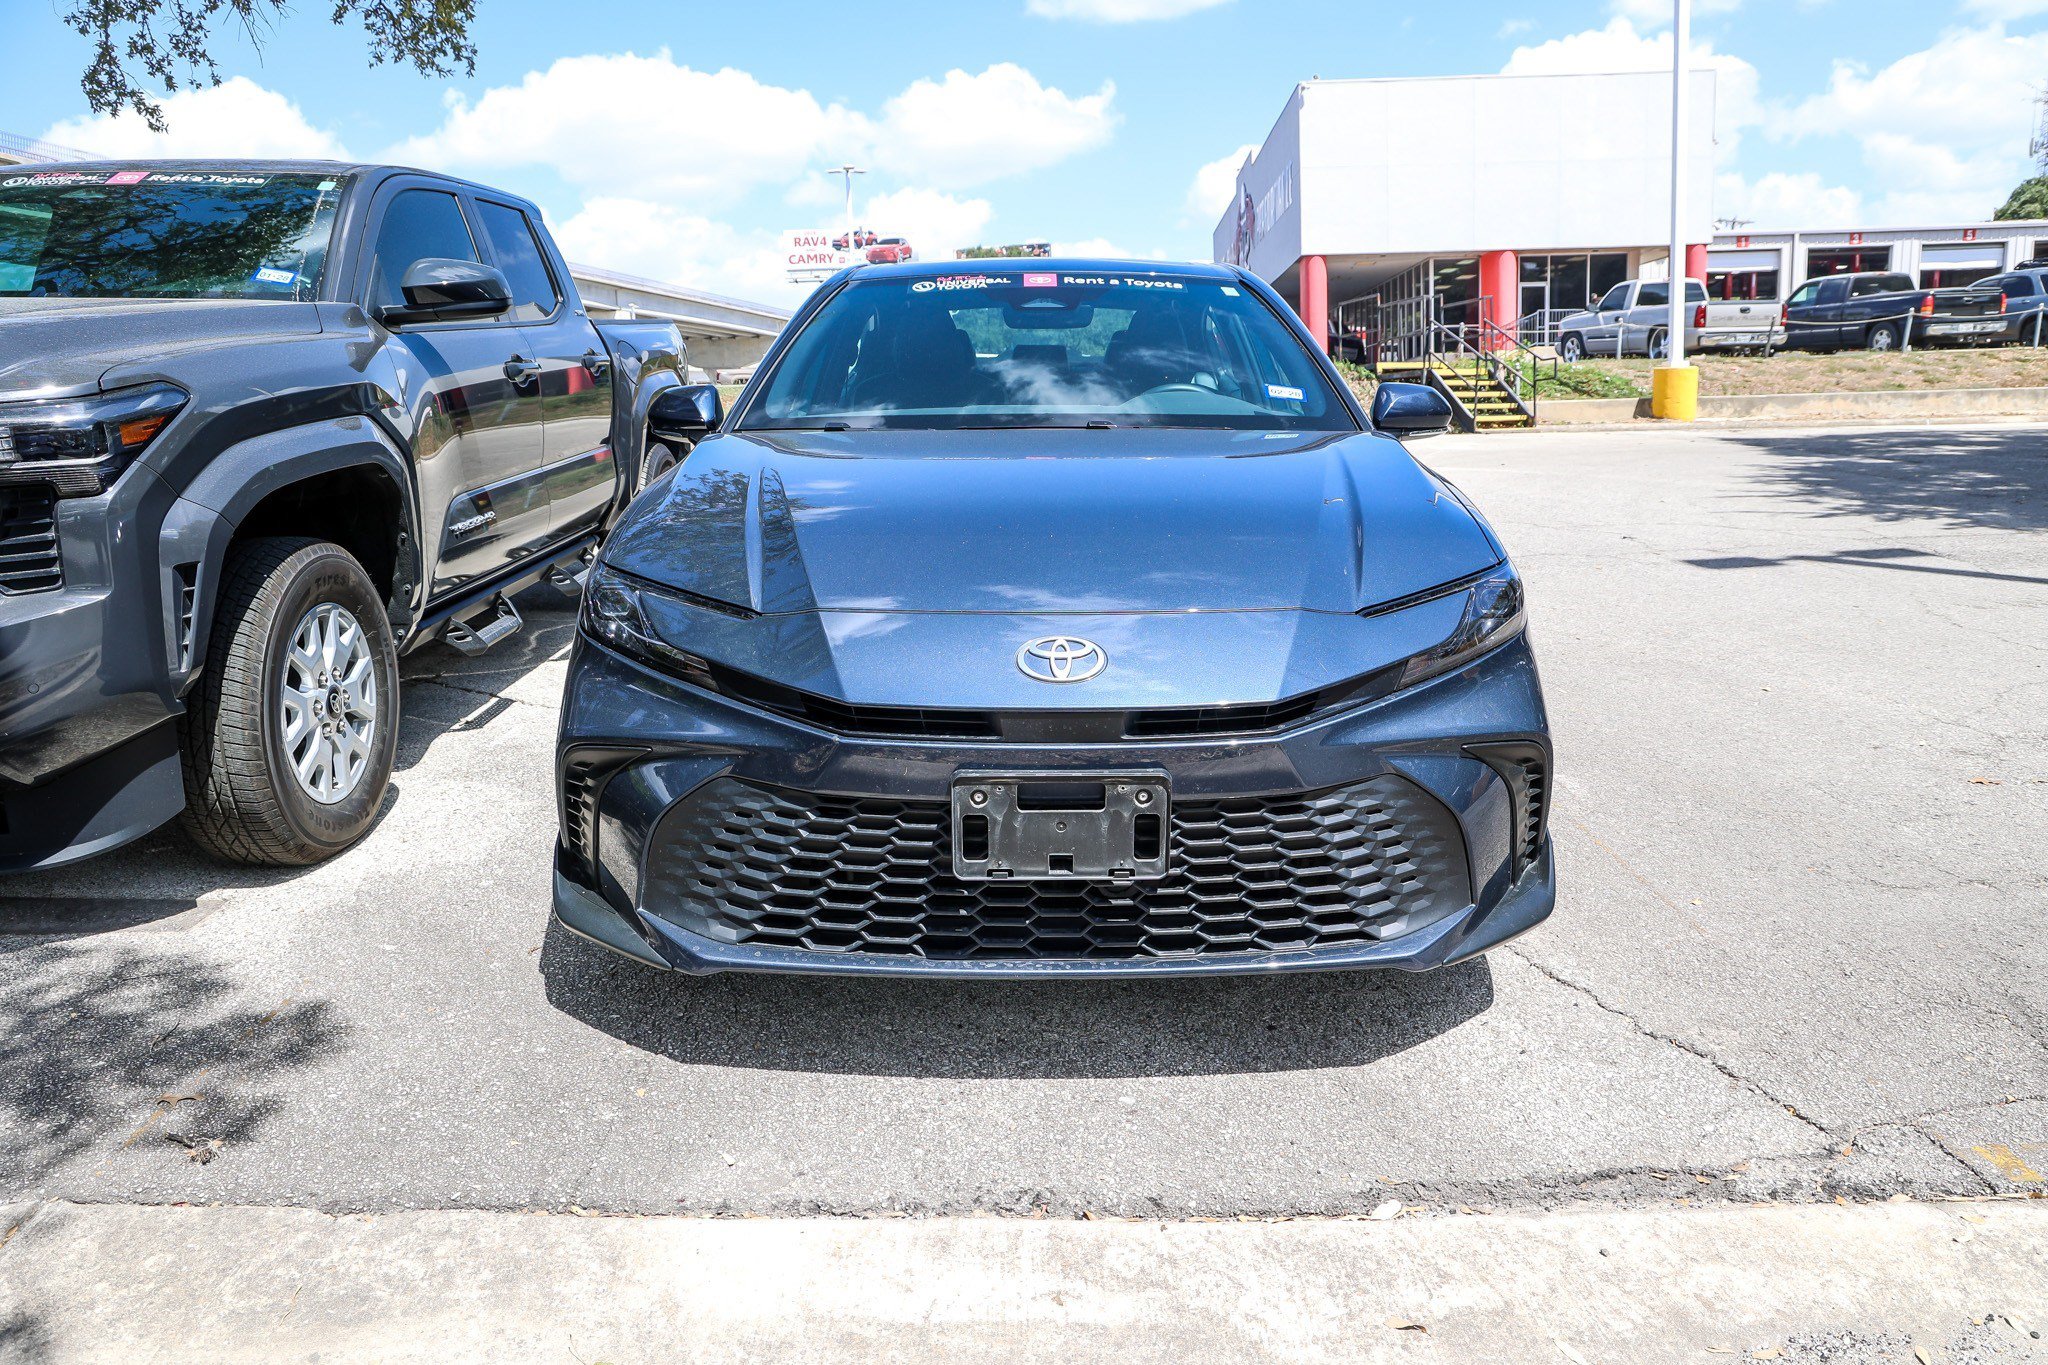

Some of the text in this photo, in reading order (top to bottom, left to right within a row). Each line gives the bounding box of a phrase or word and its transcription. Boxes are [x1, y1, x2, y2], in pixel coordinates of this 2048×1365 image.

[146, 174, 265, 184] Rent a Toyota
[1966, 229, 1973, 240] 5
[794, 236, 827, 247] RAV4
[788, 253, 834, 265] CAMRY
[936, 277, 1012, 288] UNIVERSAL
[937, 283, 988, 291] TOYOTA
[1063, 276, 1105, 285] Rent
[1124, 278, 1184, 289] Toyota
